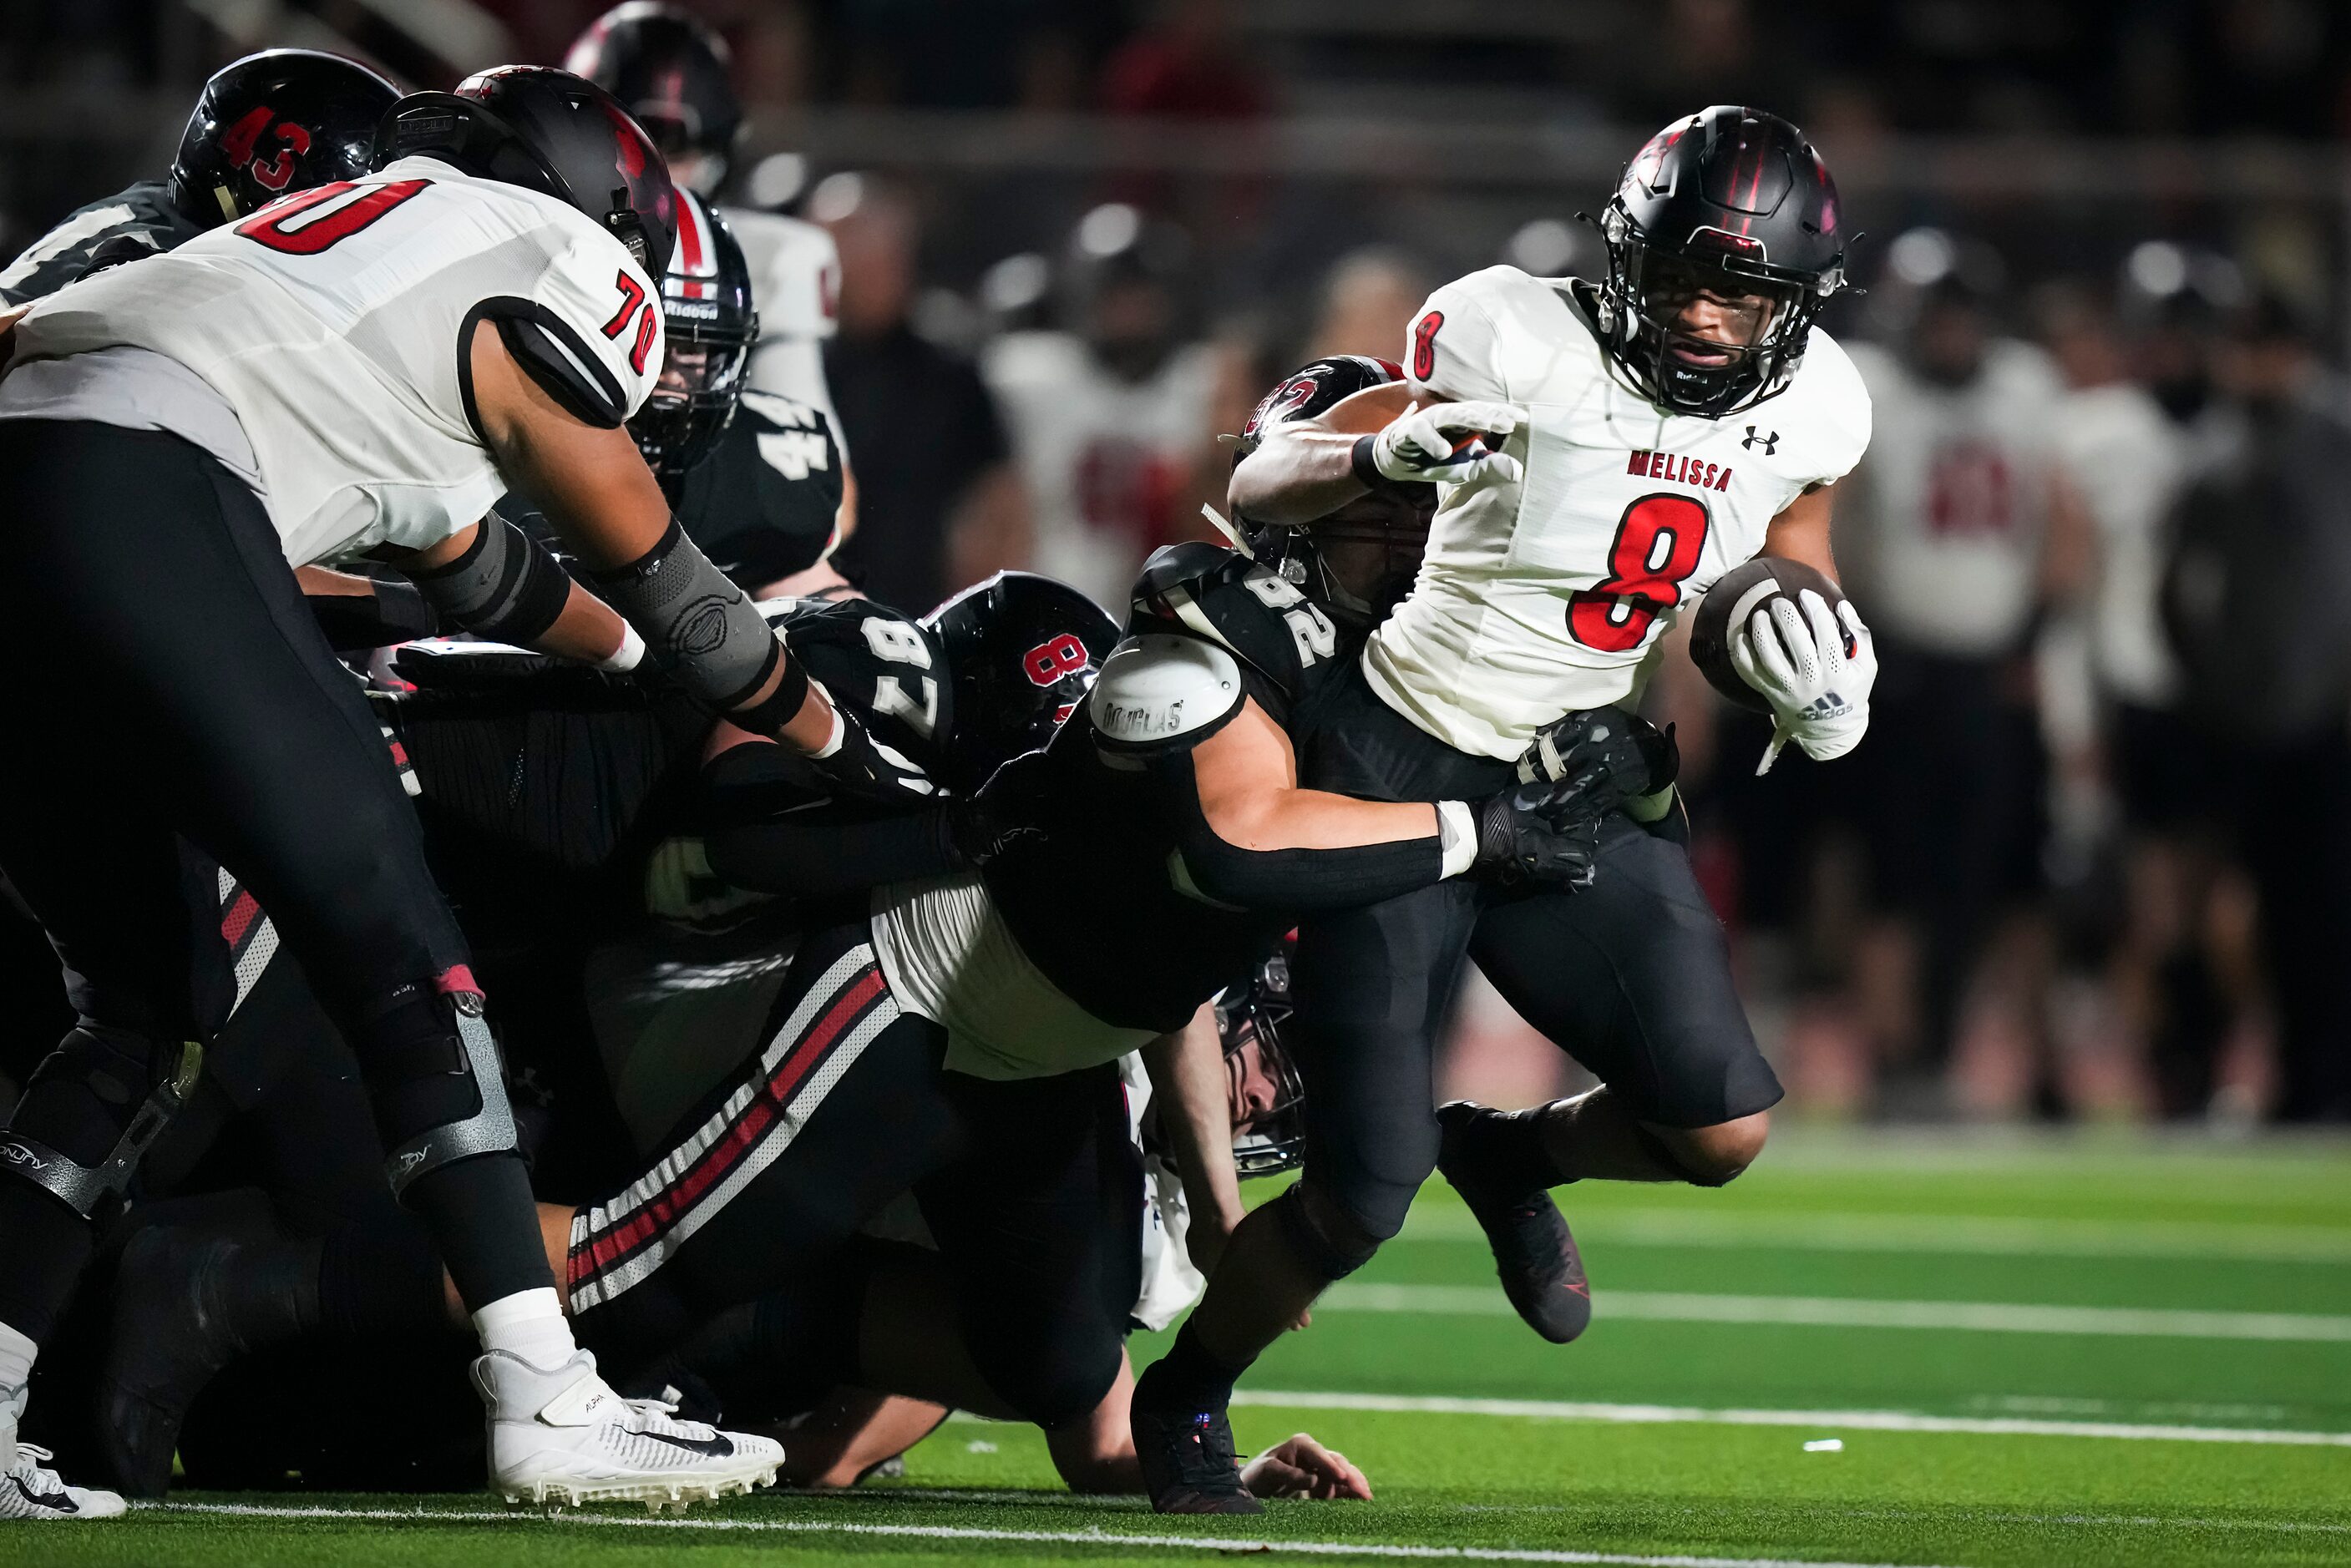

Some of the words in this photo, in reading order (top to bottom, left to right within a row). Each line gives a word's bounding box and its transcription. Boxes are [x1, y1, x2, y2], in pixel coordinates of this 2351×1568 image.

[219, 105, 311, 191] 43
[233, 180, 437, 255] 0
[600, 267, 657, 377] 70
[1414, 311, 1445, 382] 8
[1627, 450, 1732, 492] MELISSA
[1565, 492, 1709, 652] 8
[1242, 562, 1336, 669] 82
[859, 616, 937, 741] 87
[585, 1393, 605, 1414] ALPHA
